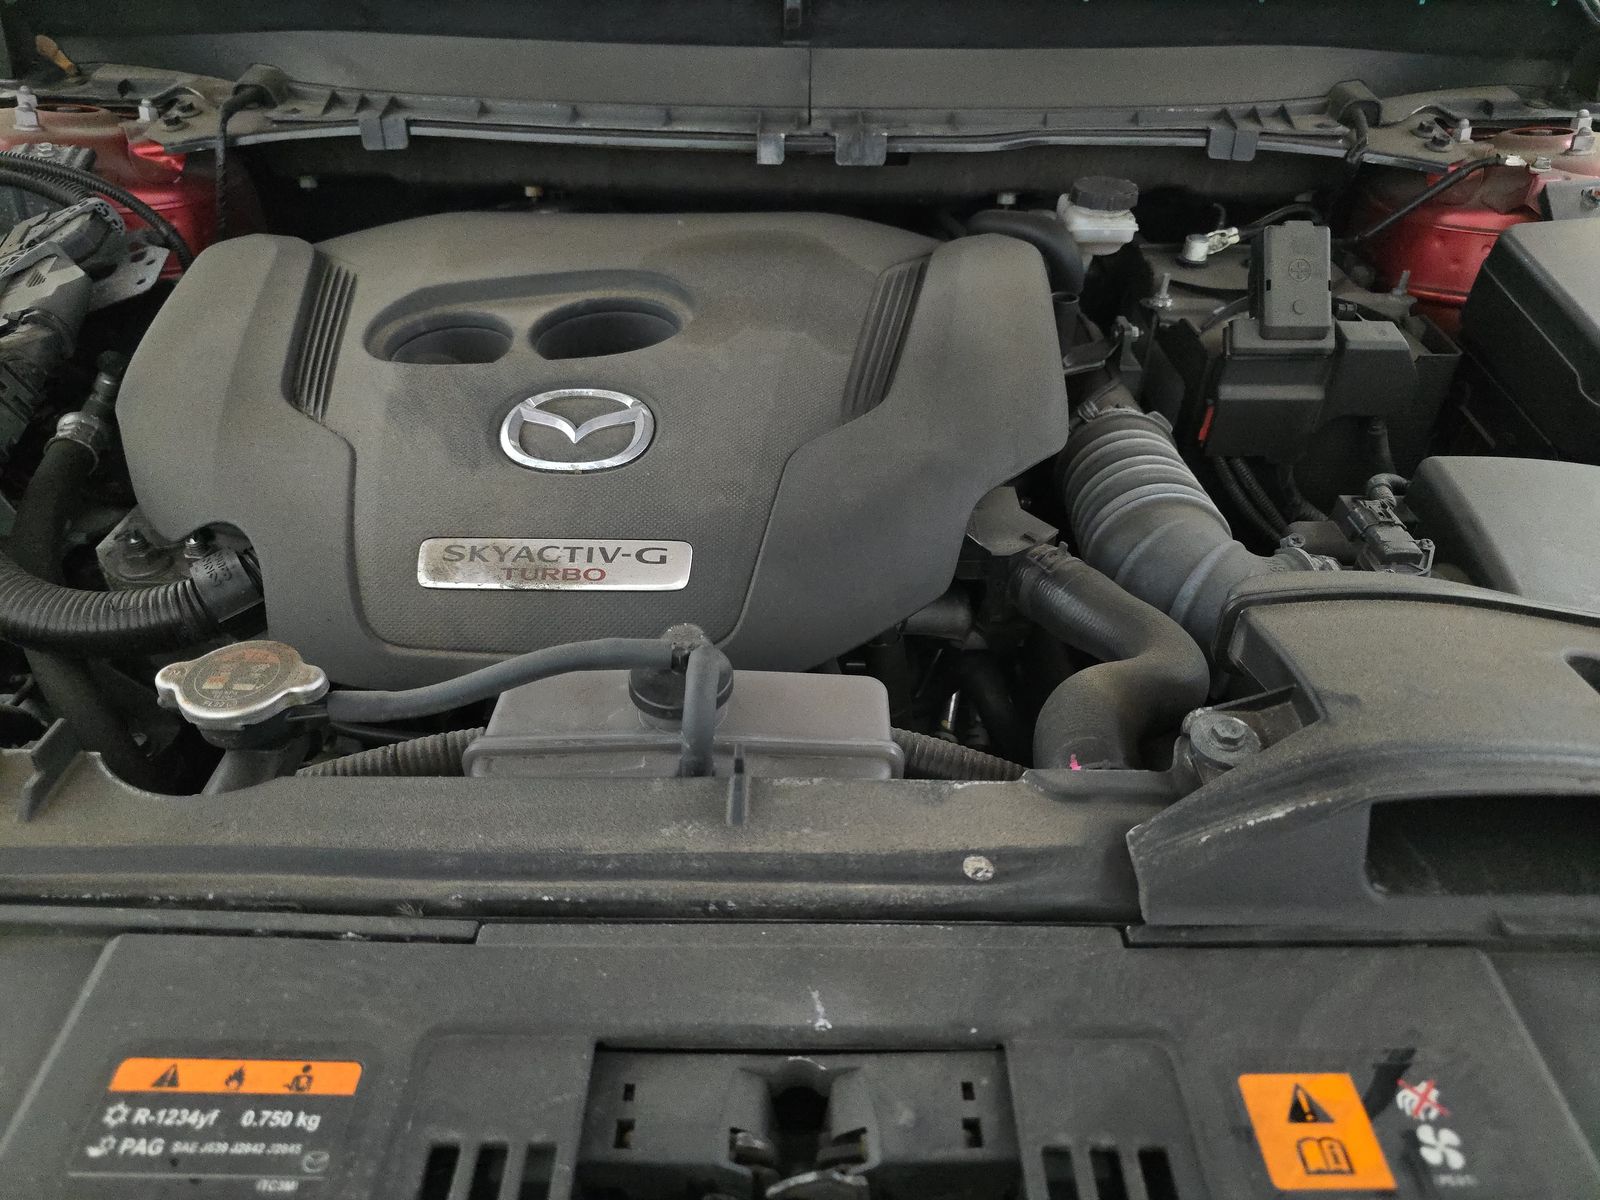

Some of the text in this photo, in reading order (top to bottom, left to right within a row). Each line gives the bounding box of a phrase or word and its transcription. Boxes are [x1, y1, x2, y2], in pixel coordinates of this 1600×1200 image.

[442, 544, 668, 565] SKYACTIV-G
[501, 567, 607, 582] TURBO
[132, 1107, 321, 1132] R-1234yf 0.750 kg
[118, 1137, 165, 1156] PAG
